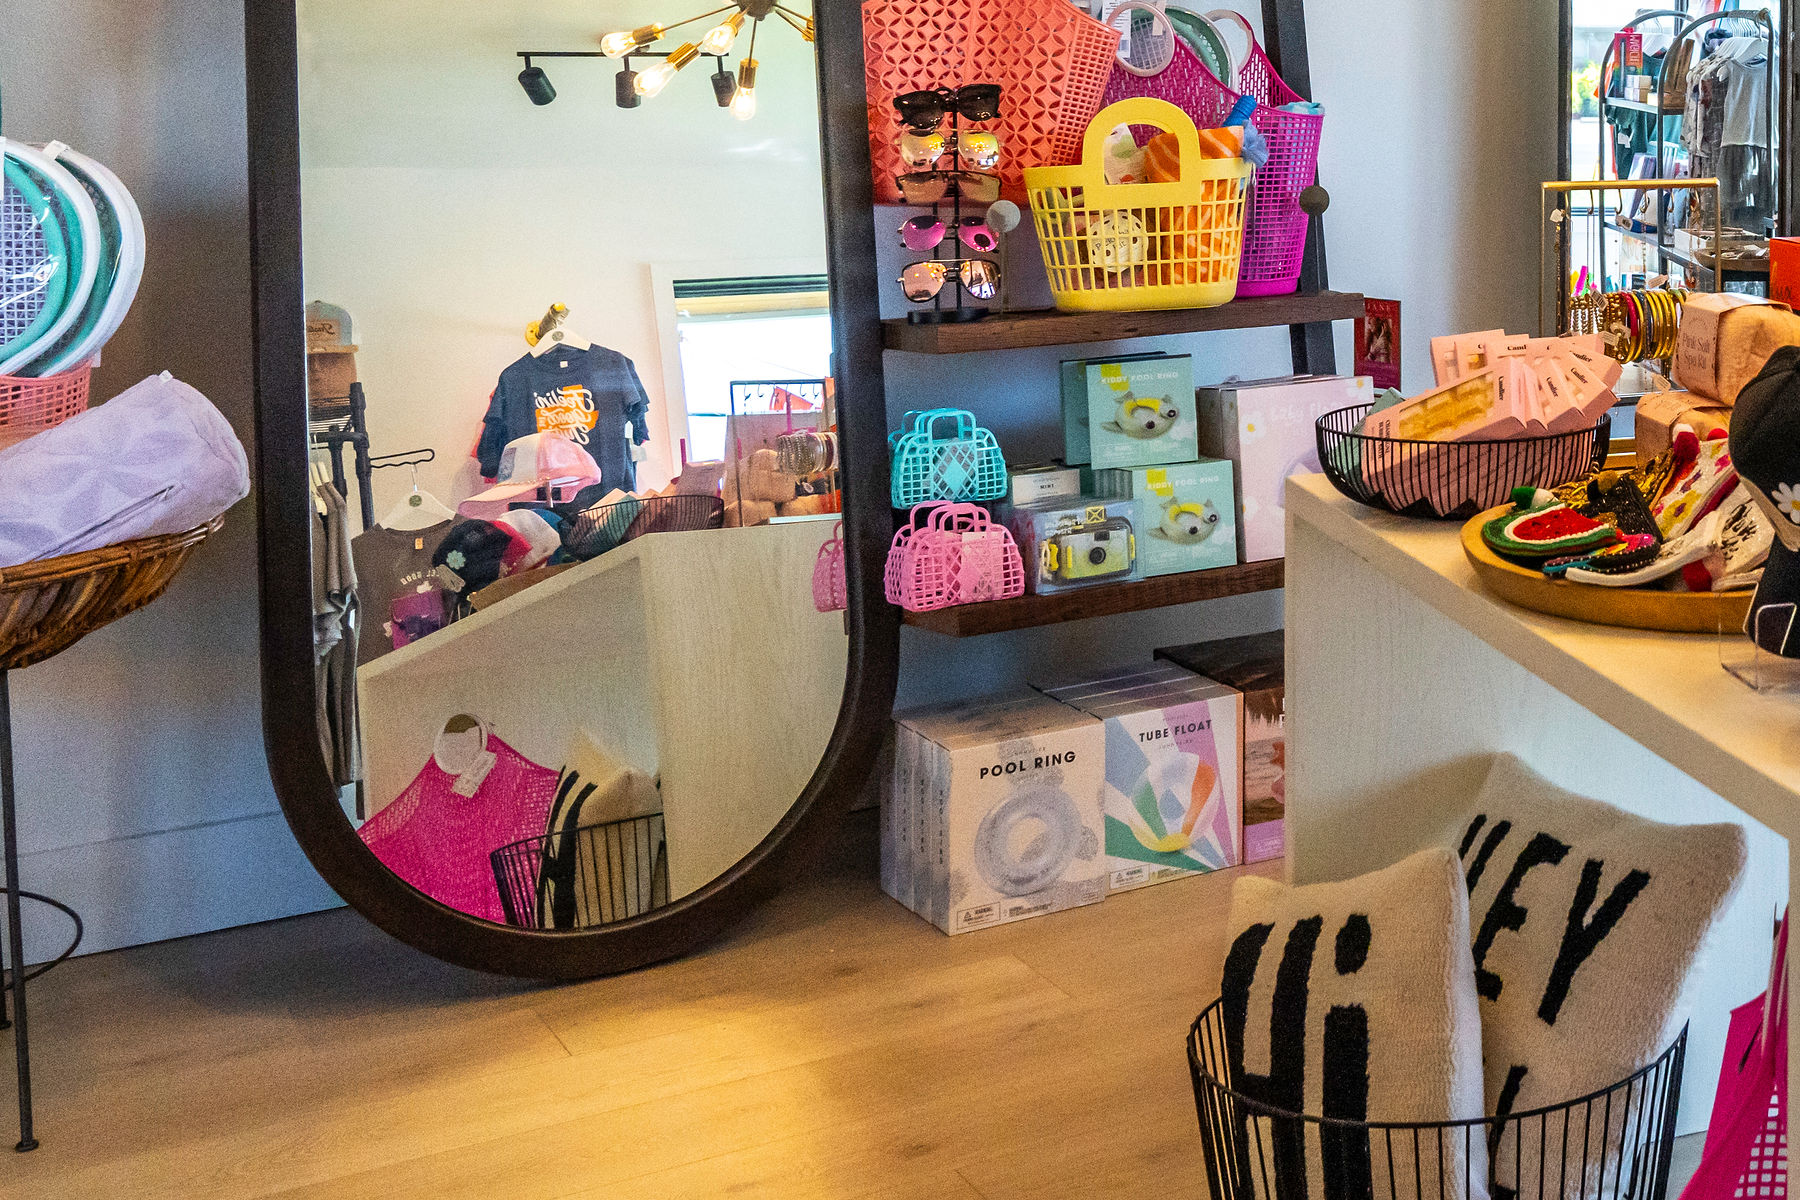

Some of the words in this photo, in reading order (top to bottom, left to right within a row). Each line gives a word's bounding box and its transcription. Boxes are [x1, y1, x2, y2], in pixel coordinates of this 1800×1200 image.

[1546, 376, 1559, 398] Candier
[1570, 367, 1588, 384] Candier
[1139, 726, 1169, 743] TUBE
[1174, 719, 1213, 736] FLOAT
[979, 761, 1026, 780] POOL
[1034, 750, 1076, 770] RING
